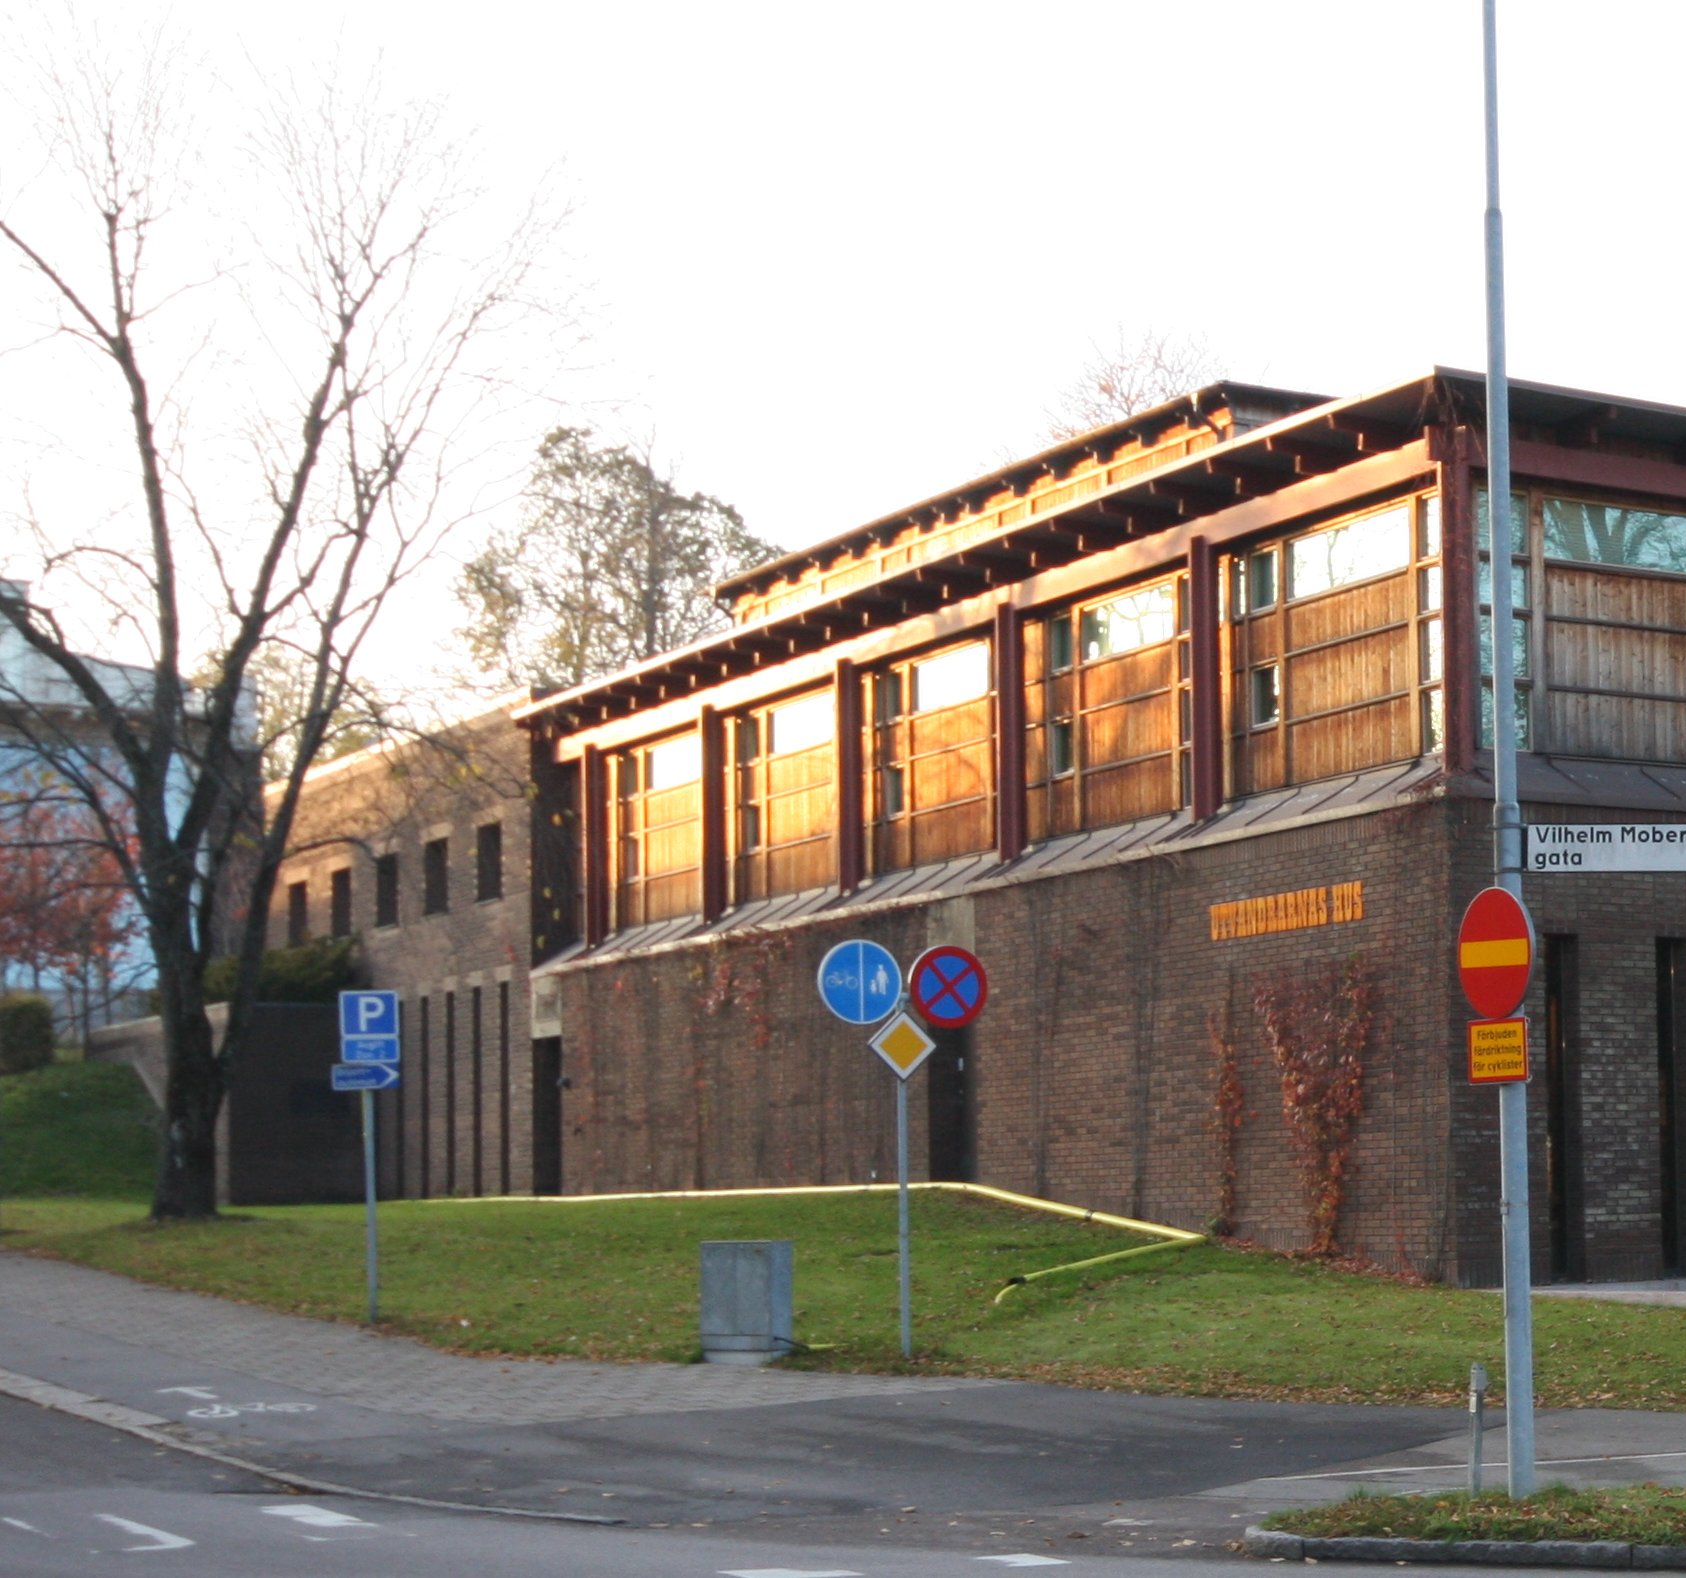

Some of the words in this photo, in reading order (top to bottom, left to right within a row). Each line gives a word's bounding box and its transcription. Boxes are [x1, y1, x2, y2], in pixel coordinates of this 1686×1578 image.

[1535, 826, 1612, 843] Vilhelm
[1535, 850, 1582, 869] gata
[1210, 886, 1328, 941] UTVANDRARNAS
[1332, 879, 1364, 923] HUS
[358, 996, 385, 1032] P
[1487, 1059, 1523, 1073] cyklister
